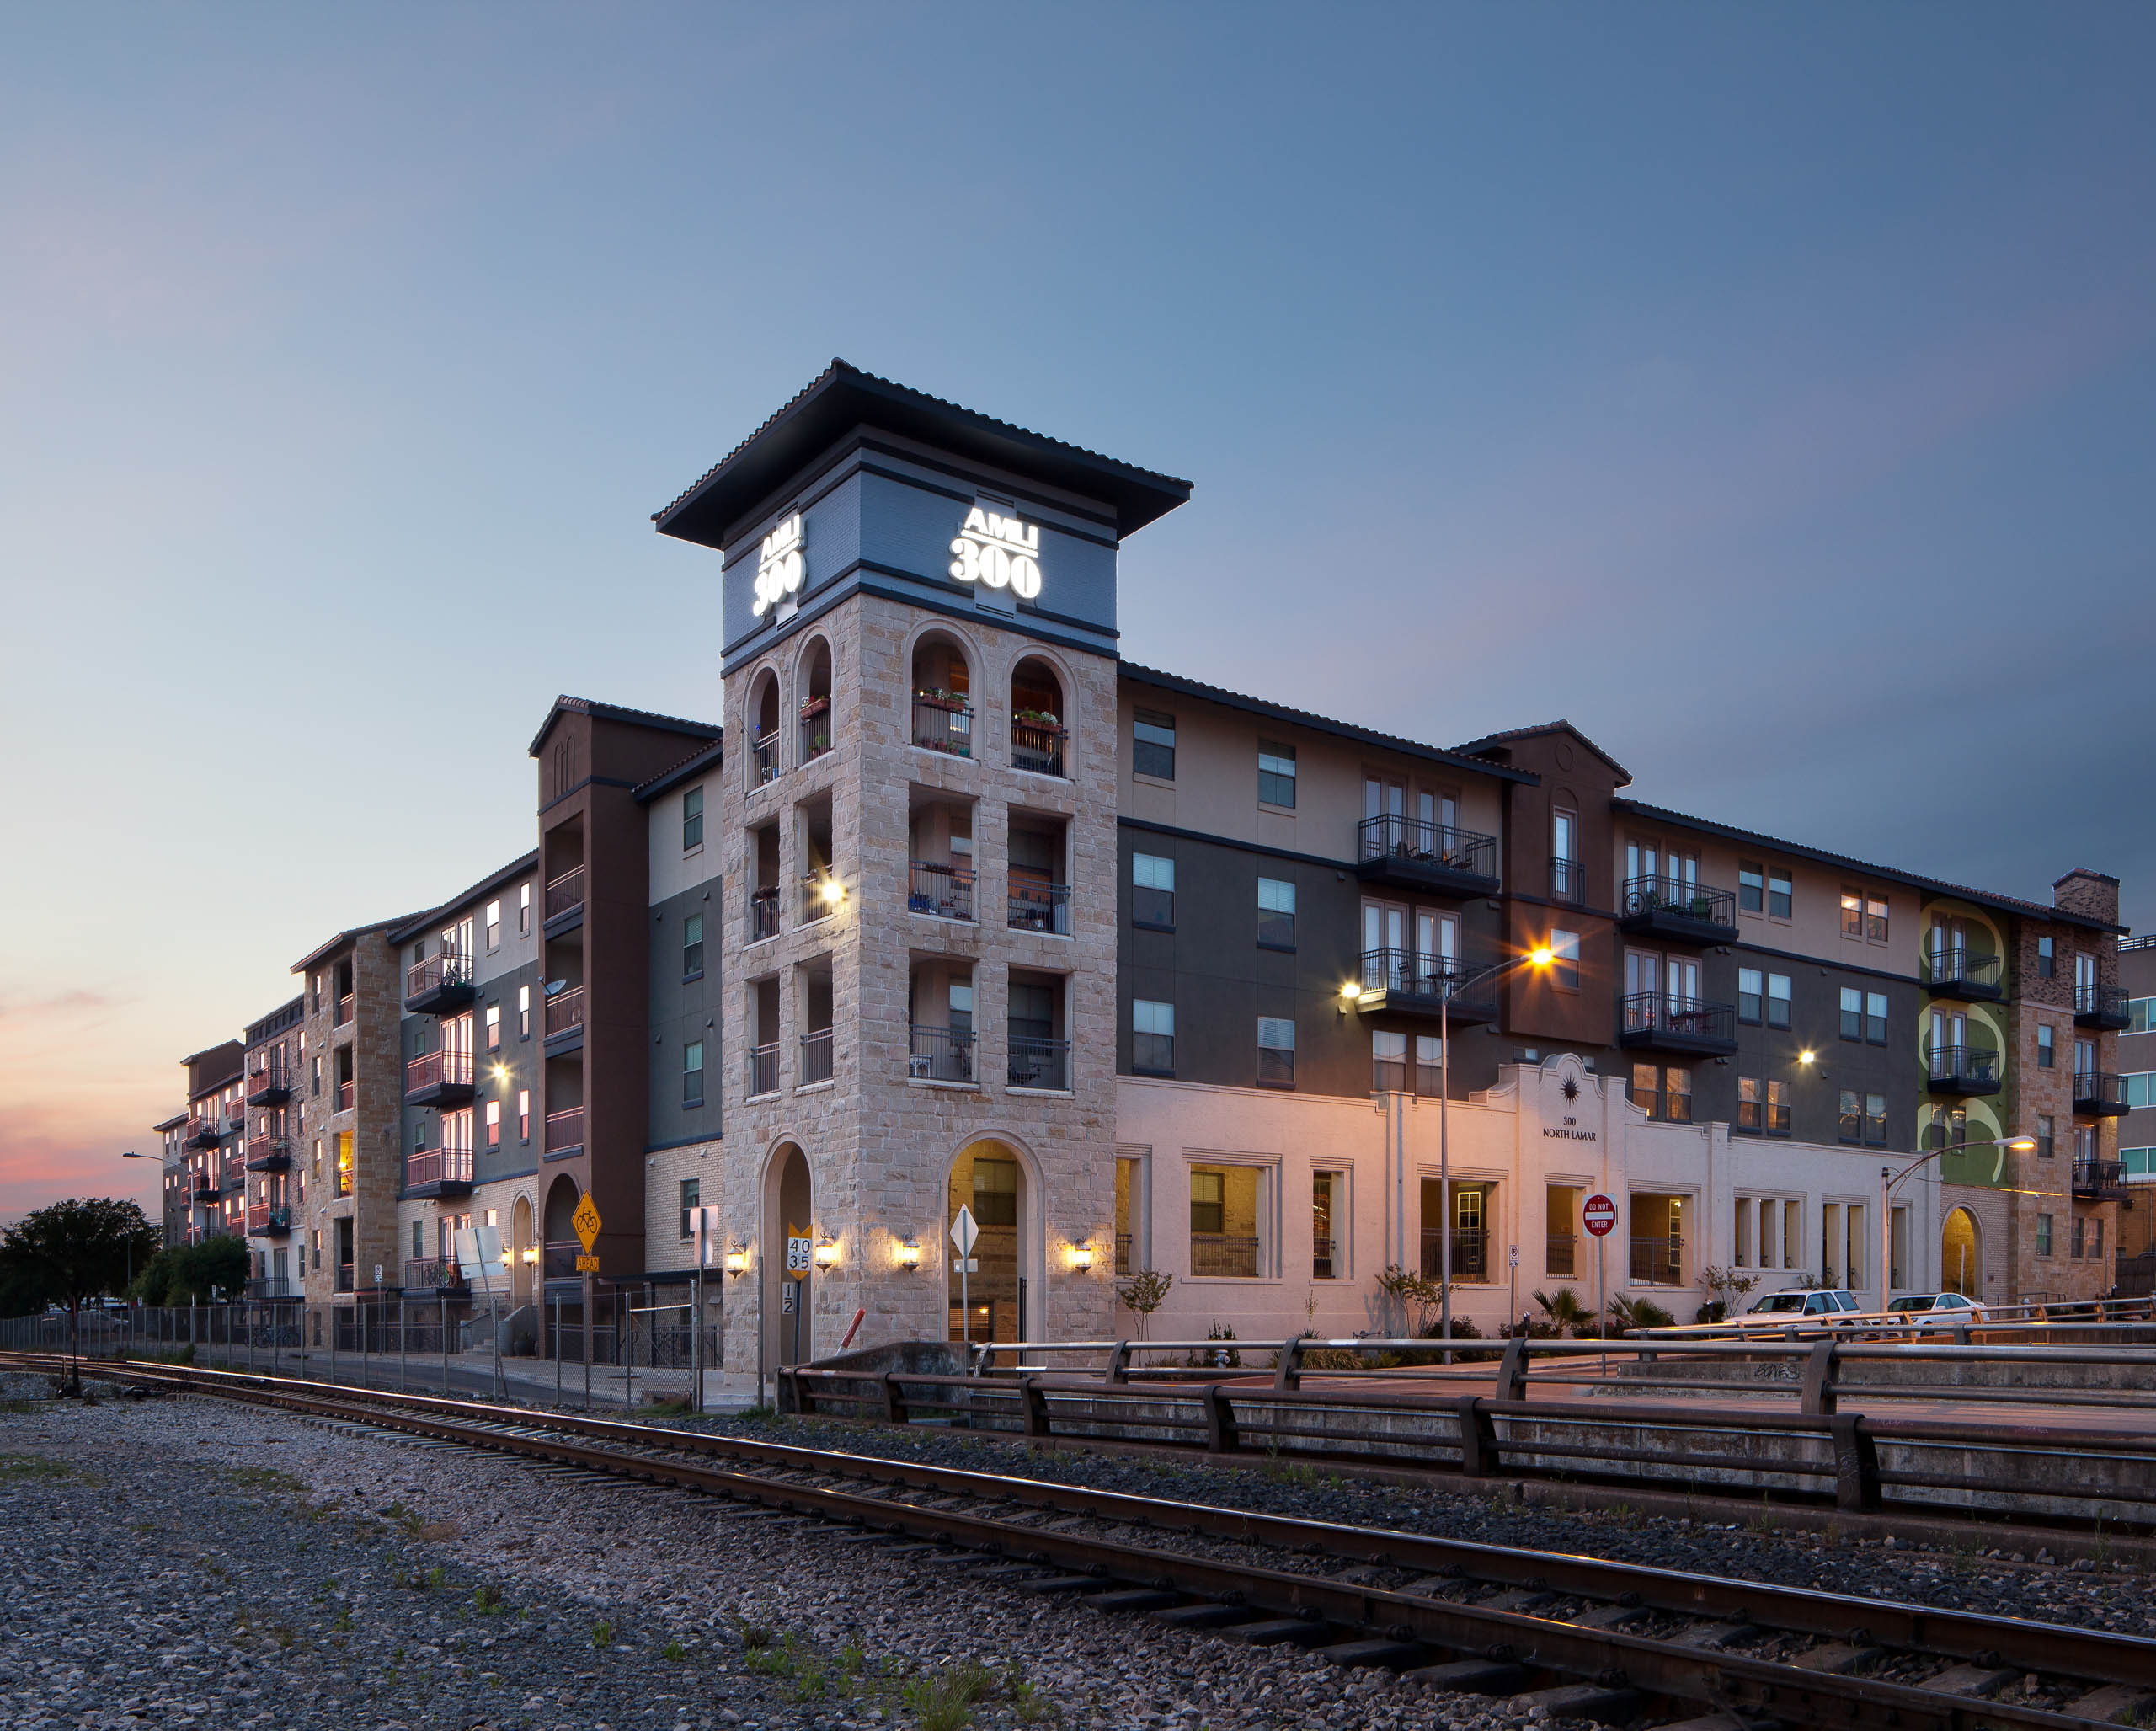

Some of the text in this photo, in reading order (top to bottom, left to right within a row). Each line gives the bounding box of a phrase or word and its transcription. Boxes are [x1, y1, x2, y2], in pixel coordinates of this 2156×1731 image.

[965, 507, 1038, 550] AMLI
[760, 514, 800, 564] AMLI
[949, 538, 1041, 599] 300
[752, 550, 802, 617] 300
[1563, 1116, 1577, 1126] 300
[1543, 1128, 1597, 1141] NORTH LAMAR
[790, 1239, 810, 1253] 40
[578, 1258, 598, 1269] AHEAD
[789, 1255, 809, 1269] 35
